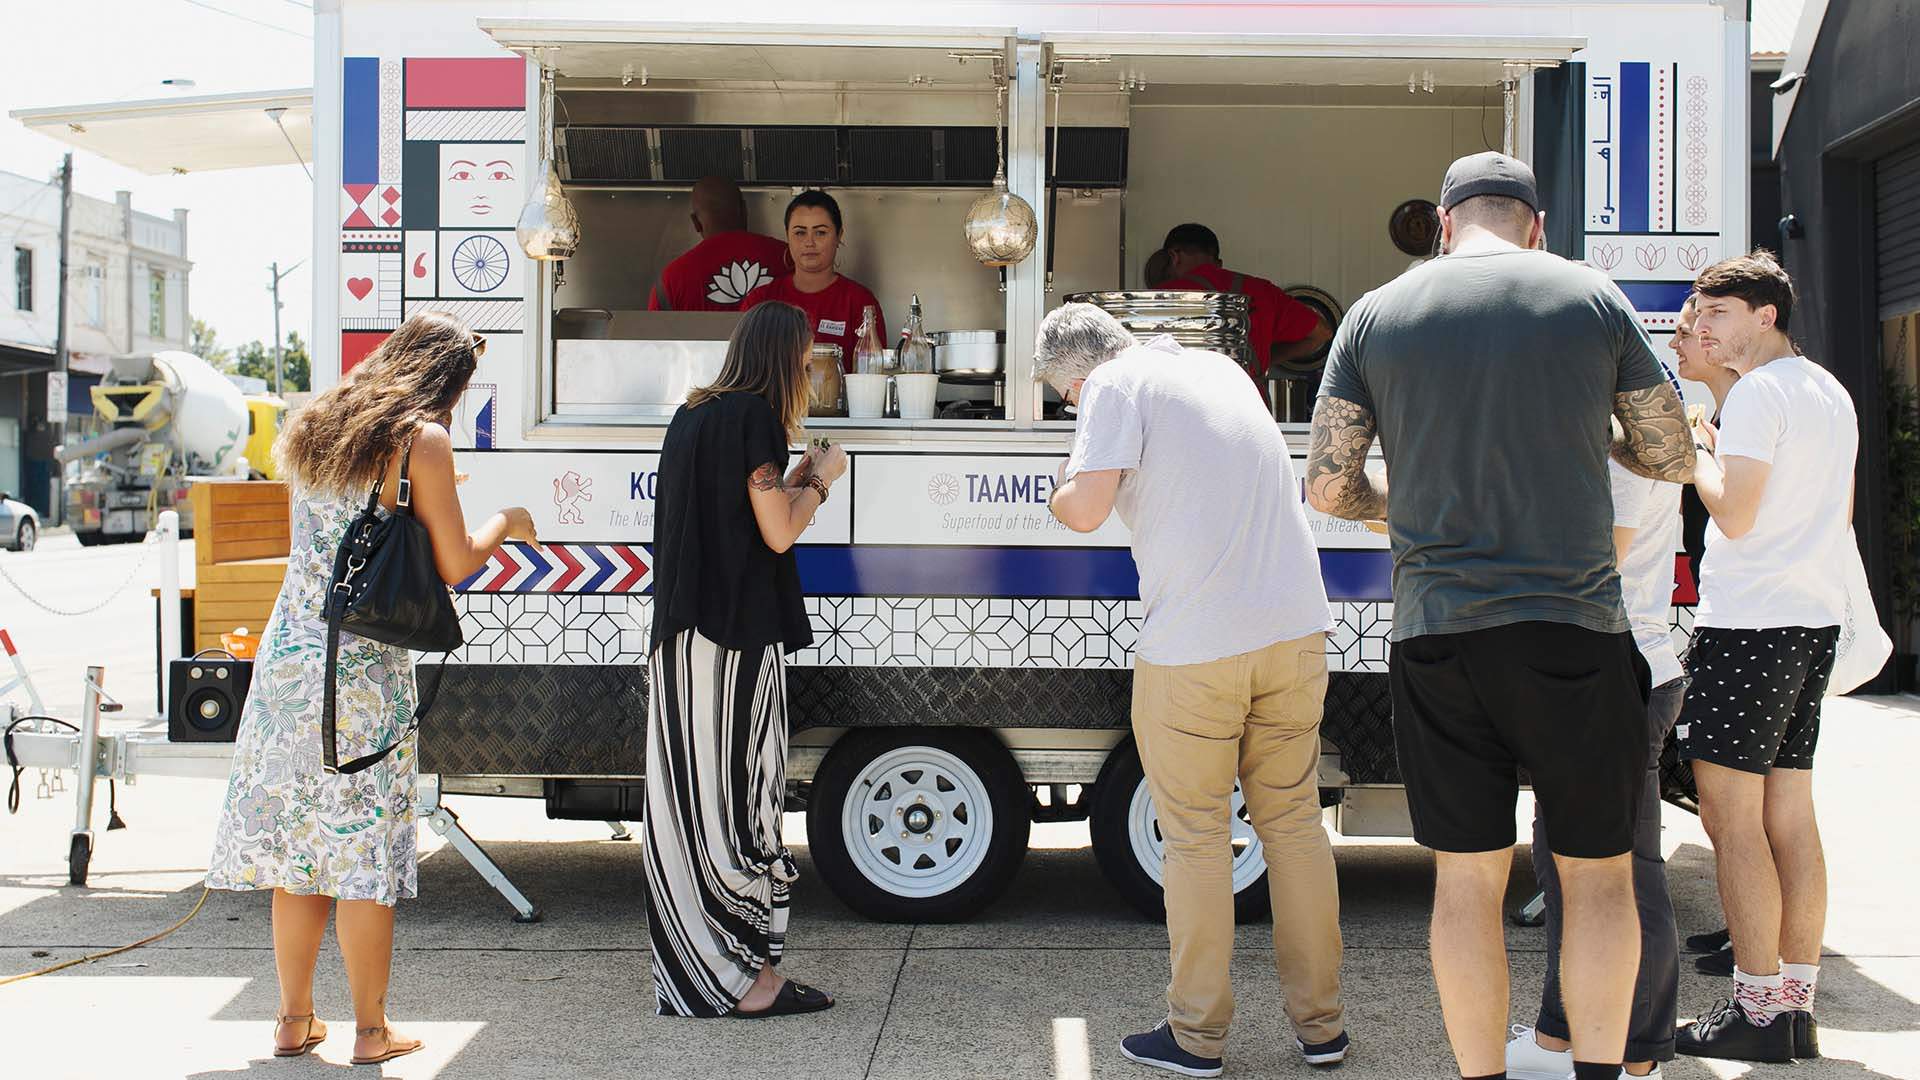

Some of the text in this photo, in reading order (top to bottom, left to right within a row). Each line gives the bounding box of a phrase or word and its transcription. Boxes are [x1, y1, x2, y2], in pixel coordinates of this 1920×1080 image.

[1592, 76, 1615, 225] القاهرة
[610, 511, 629, 527] The
[942, 512, 1002, 531] Superfood
[1005, 513, 1019, 530] of
[1023, 514, 1042, 530] the
